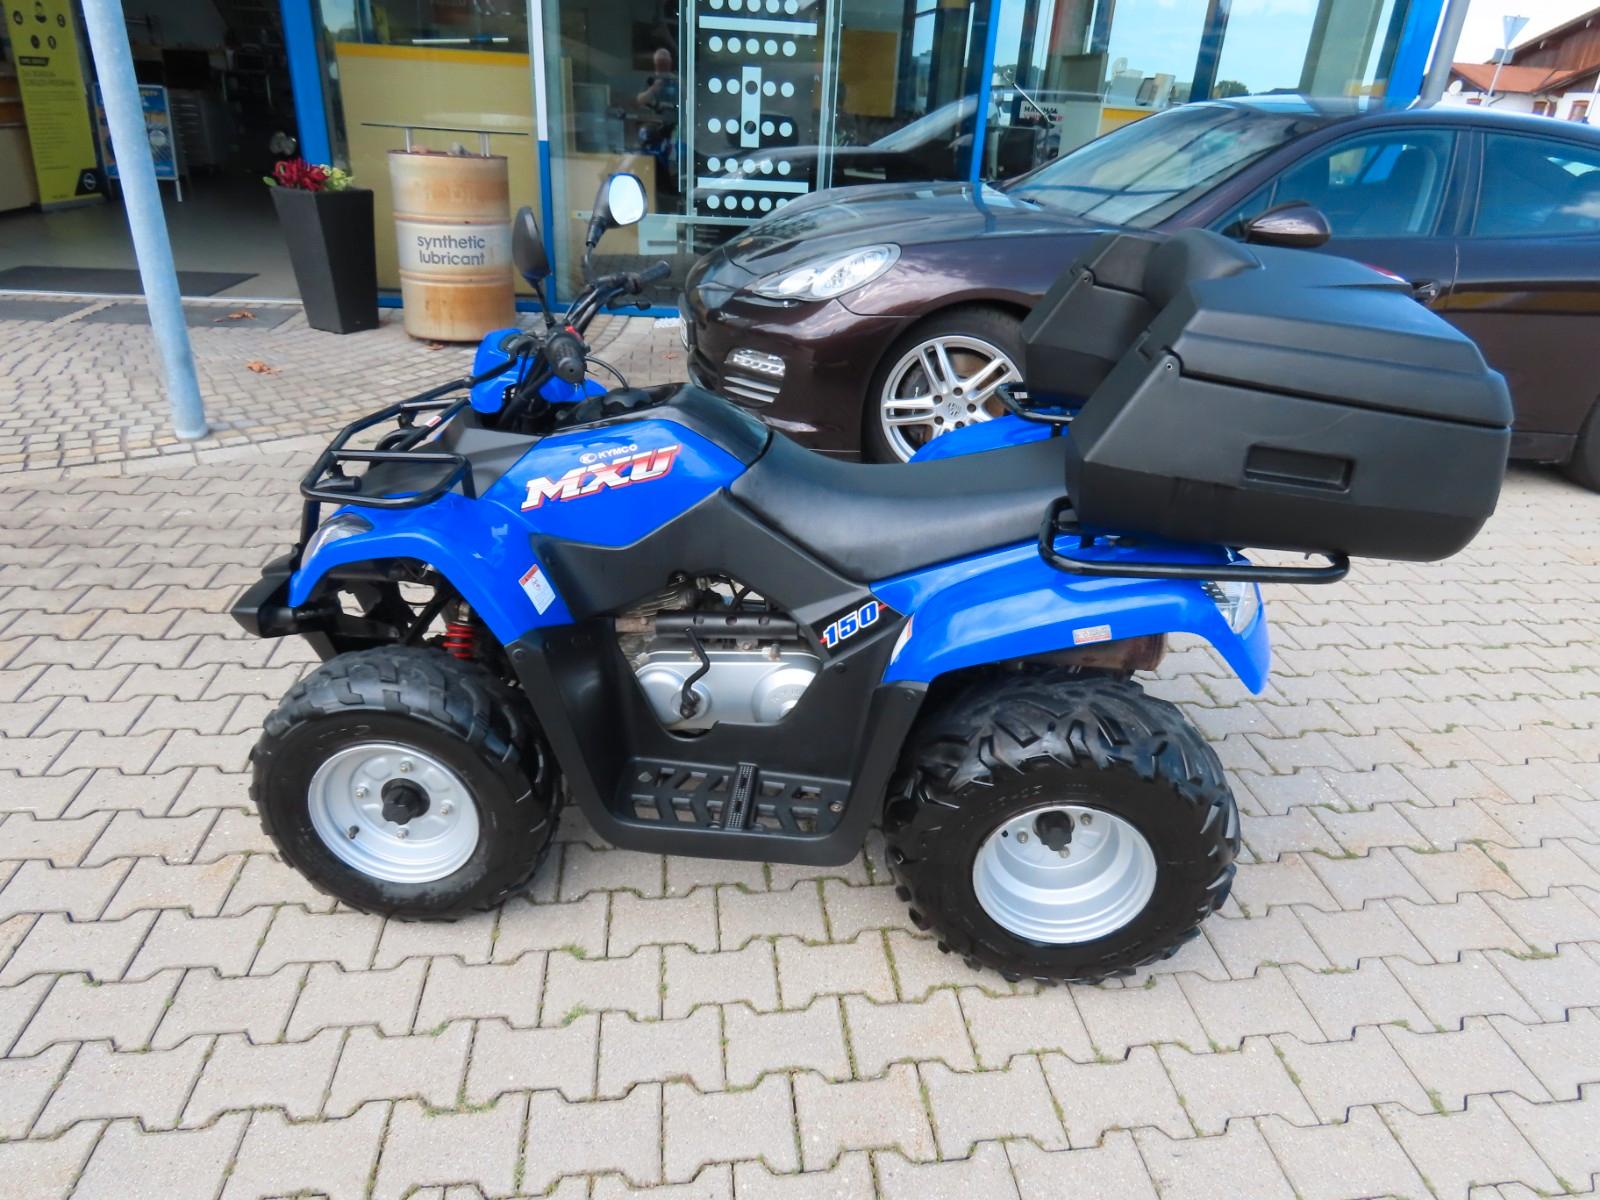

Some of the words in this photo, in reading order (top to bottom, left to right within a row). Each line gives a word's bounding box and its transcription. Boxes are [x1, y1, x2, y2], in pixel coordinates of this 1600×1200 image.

[417, 235, 486, 250] synthetic
[419, 250, 485, 265] lubricant
[598, 443, 638, 459] KYMCO
[520, 444, 682, 512] MXU
[823, 600, 879, 648] 150
